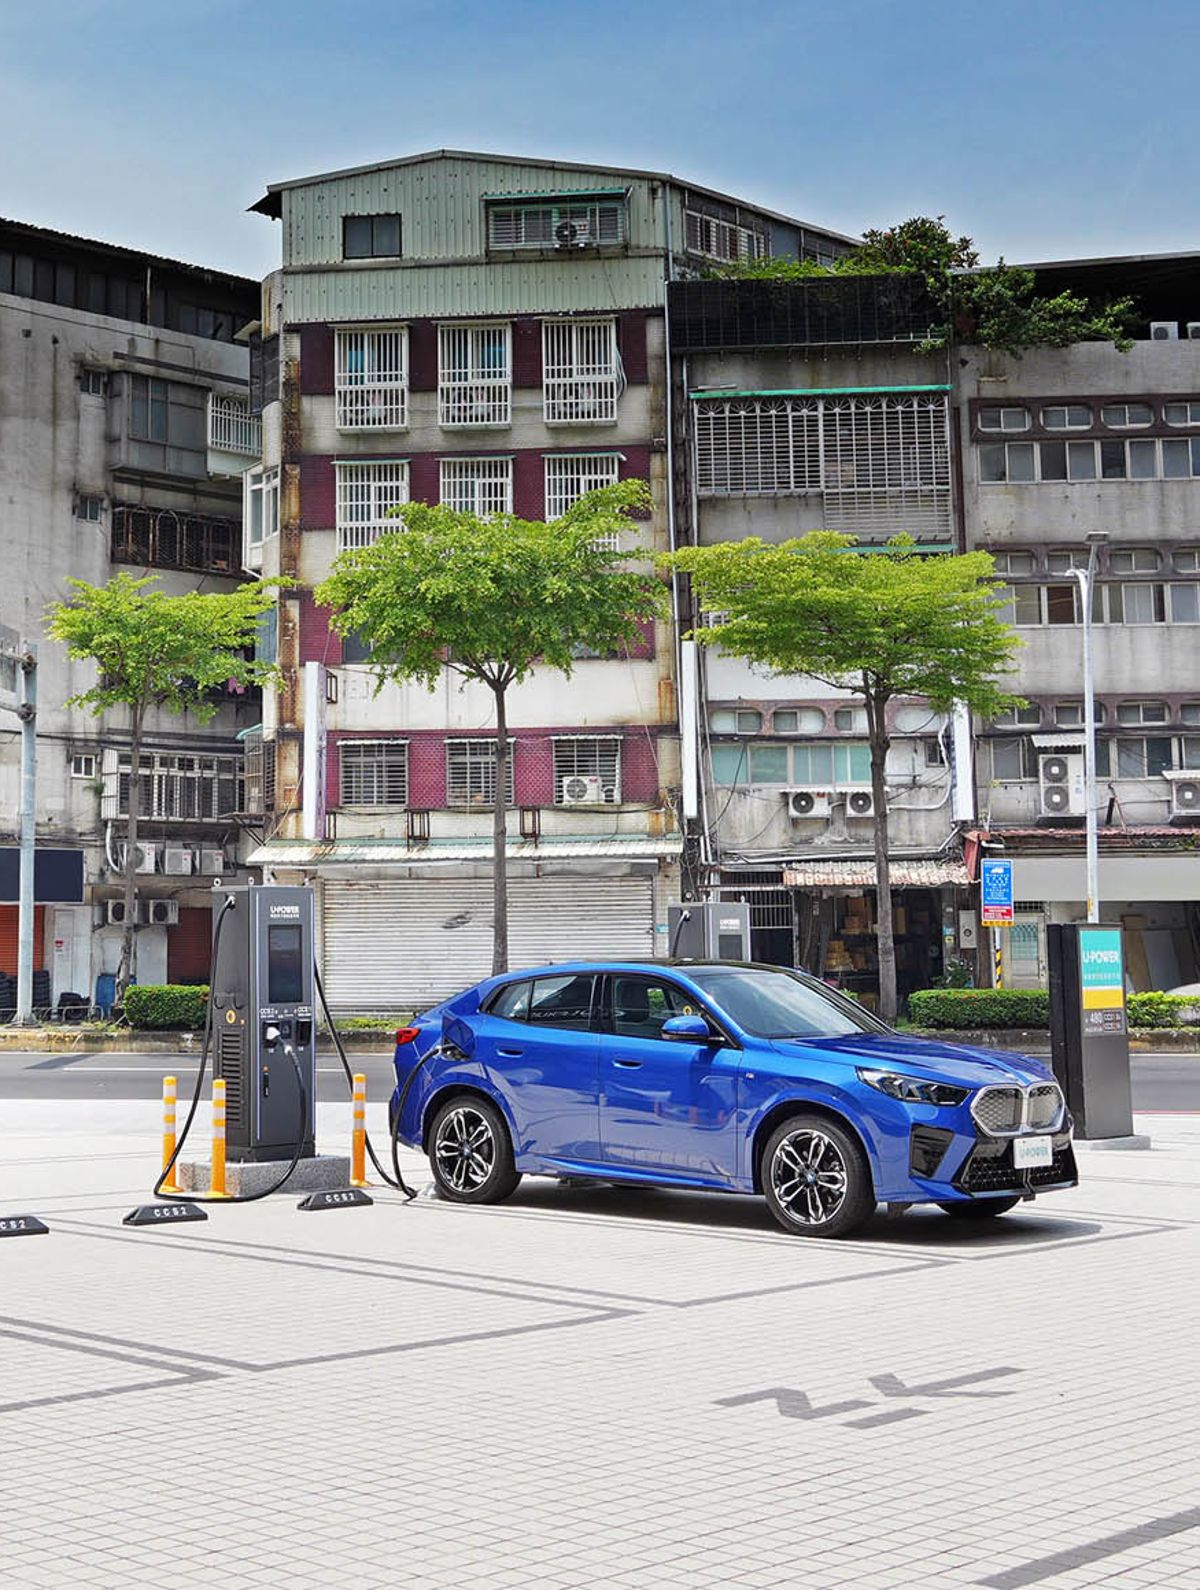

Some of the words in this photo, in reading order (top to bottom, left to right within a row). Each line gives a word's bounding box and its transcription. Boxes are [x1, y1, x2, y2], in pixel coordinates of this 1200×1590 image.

[1083, 949, 1120, 964] U-POWER
[325, 1192, 355, 1203] CCS2
[154, 1206, 187, 1217] CCS2
